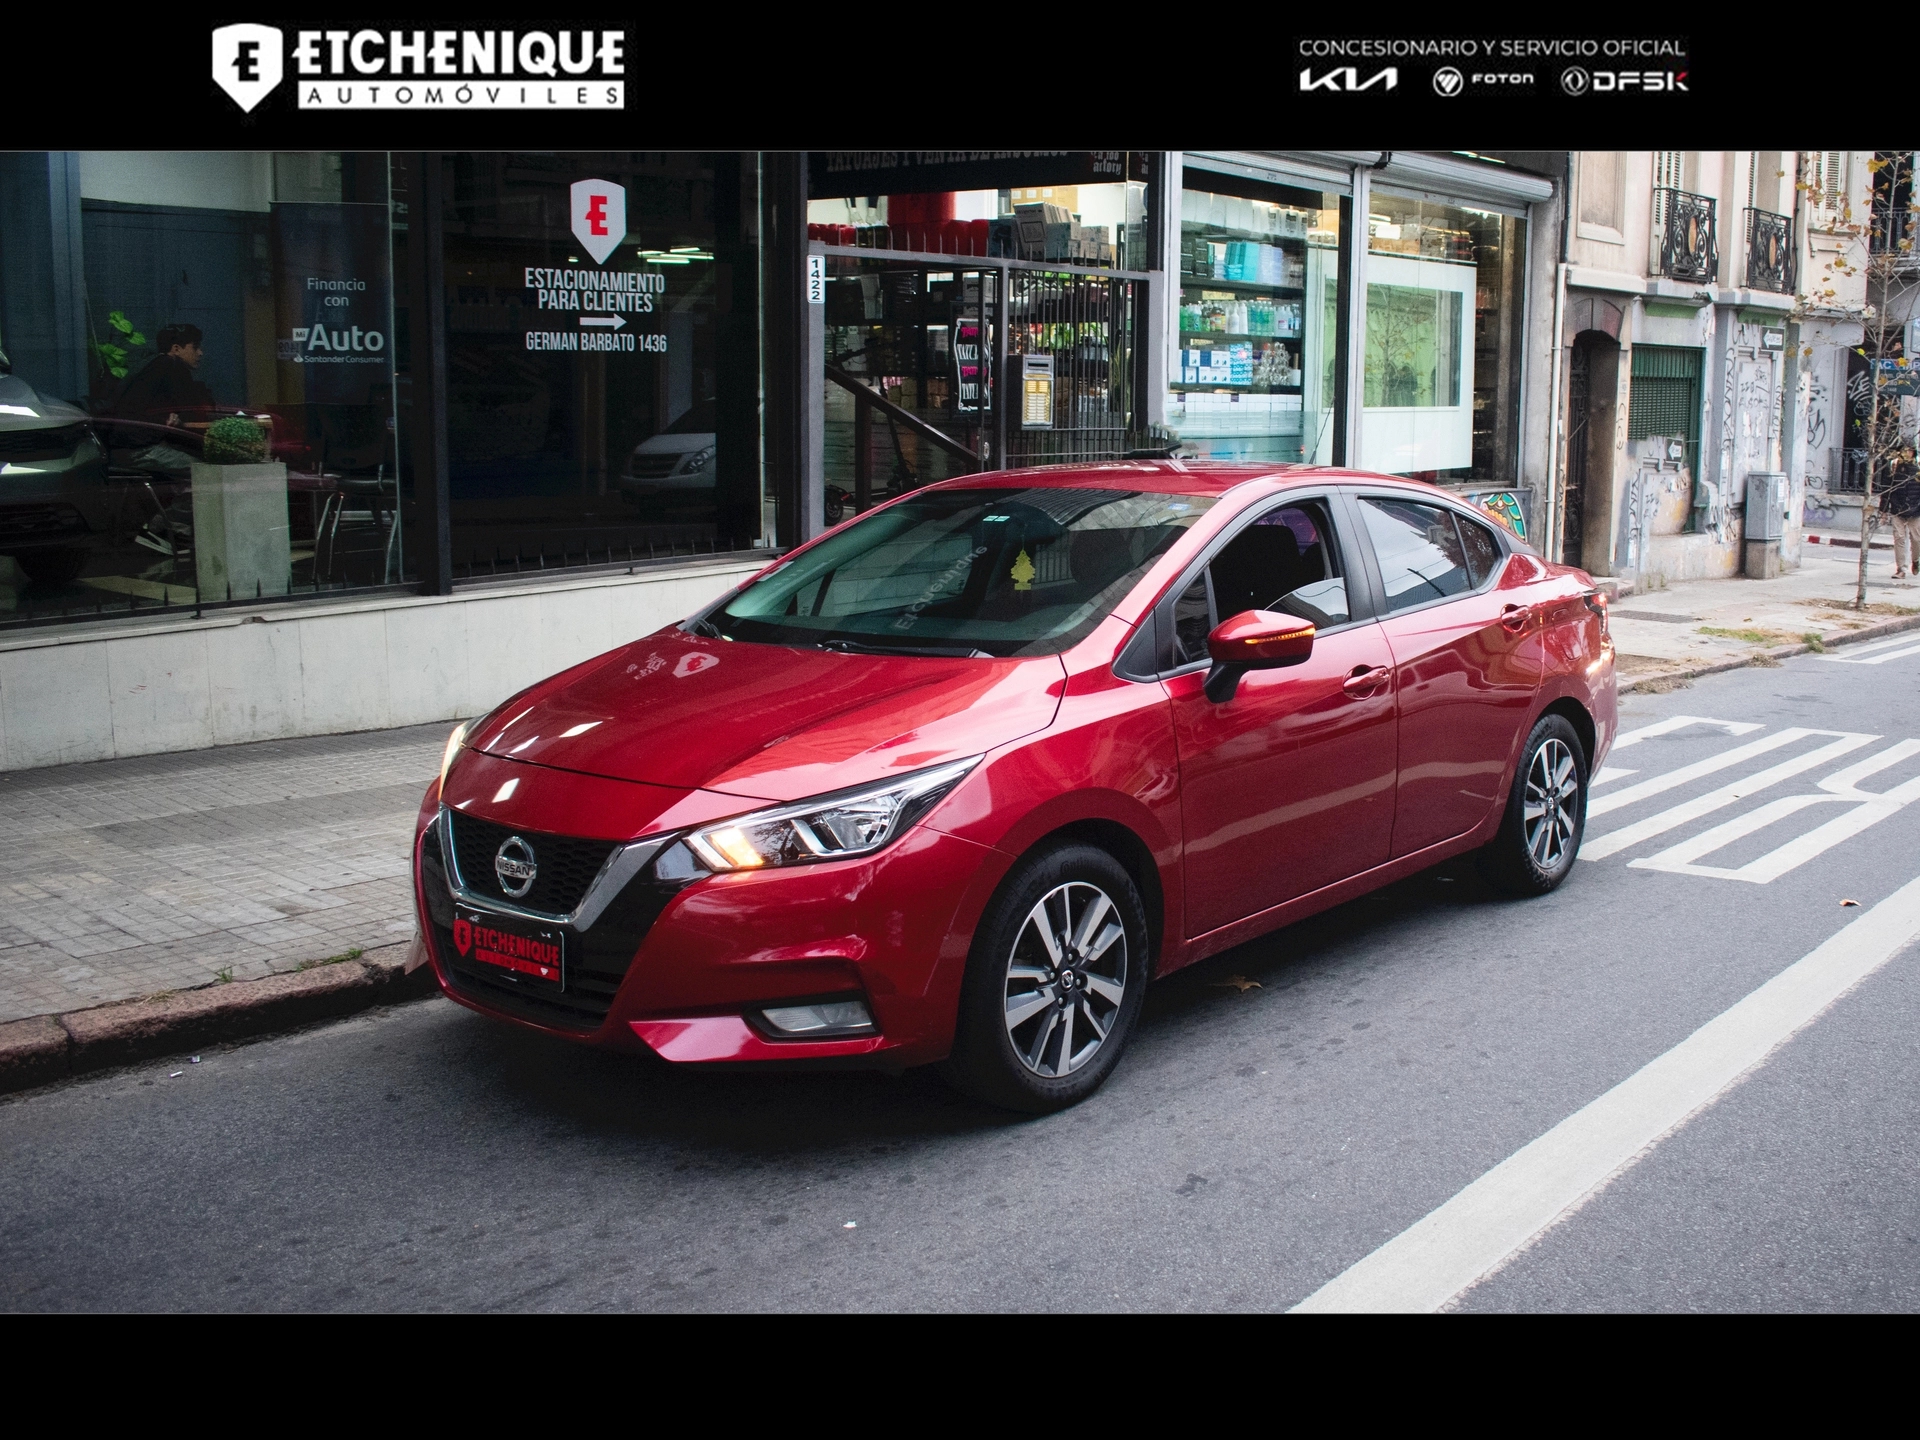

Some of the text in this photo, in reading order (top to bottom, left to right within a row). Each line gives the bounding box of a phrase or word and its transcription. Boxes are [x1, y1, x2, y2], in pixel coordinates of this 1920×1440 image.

[585, 195, 608, 236] E
[308, 278, 366, 291] Financia
[525, 267, 665, 294] ESTACIONAMIENTO
[811, 258, 821, 300] 1422
[325, 296, 349, 307] con
[538, 288, 653, 313] PARA CLIENTES
[308, 324, 384, 351] Auto
[526, 331, 667, 353] GERMAN BARBATO 1436
[304, 355, 385, 363] Santander Consumer
[496, 860, 531, 876] NISSAN
[474, 926, 559, 966] ETCHENIQUE
